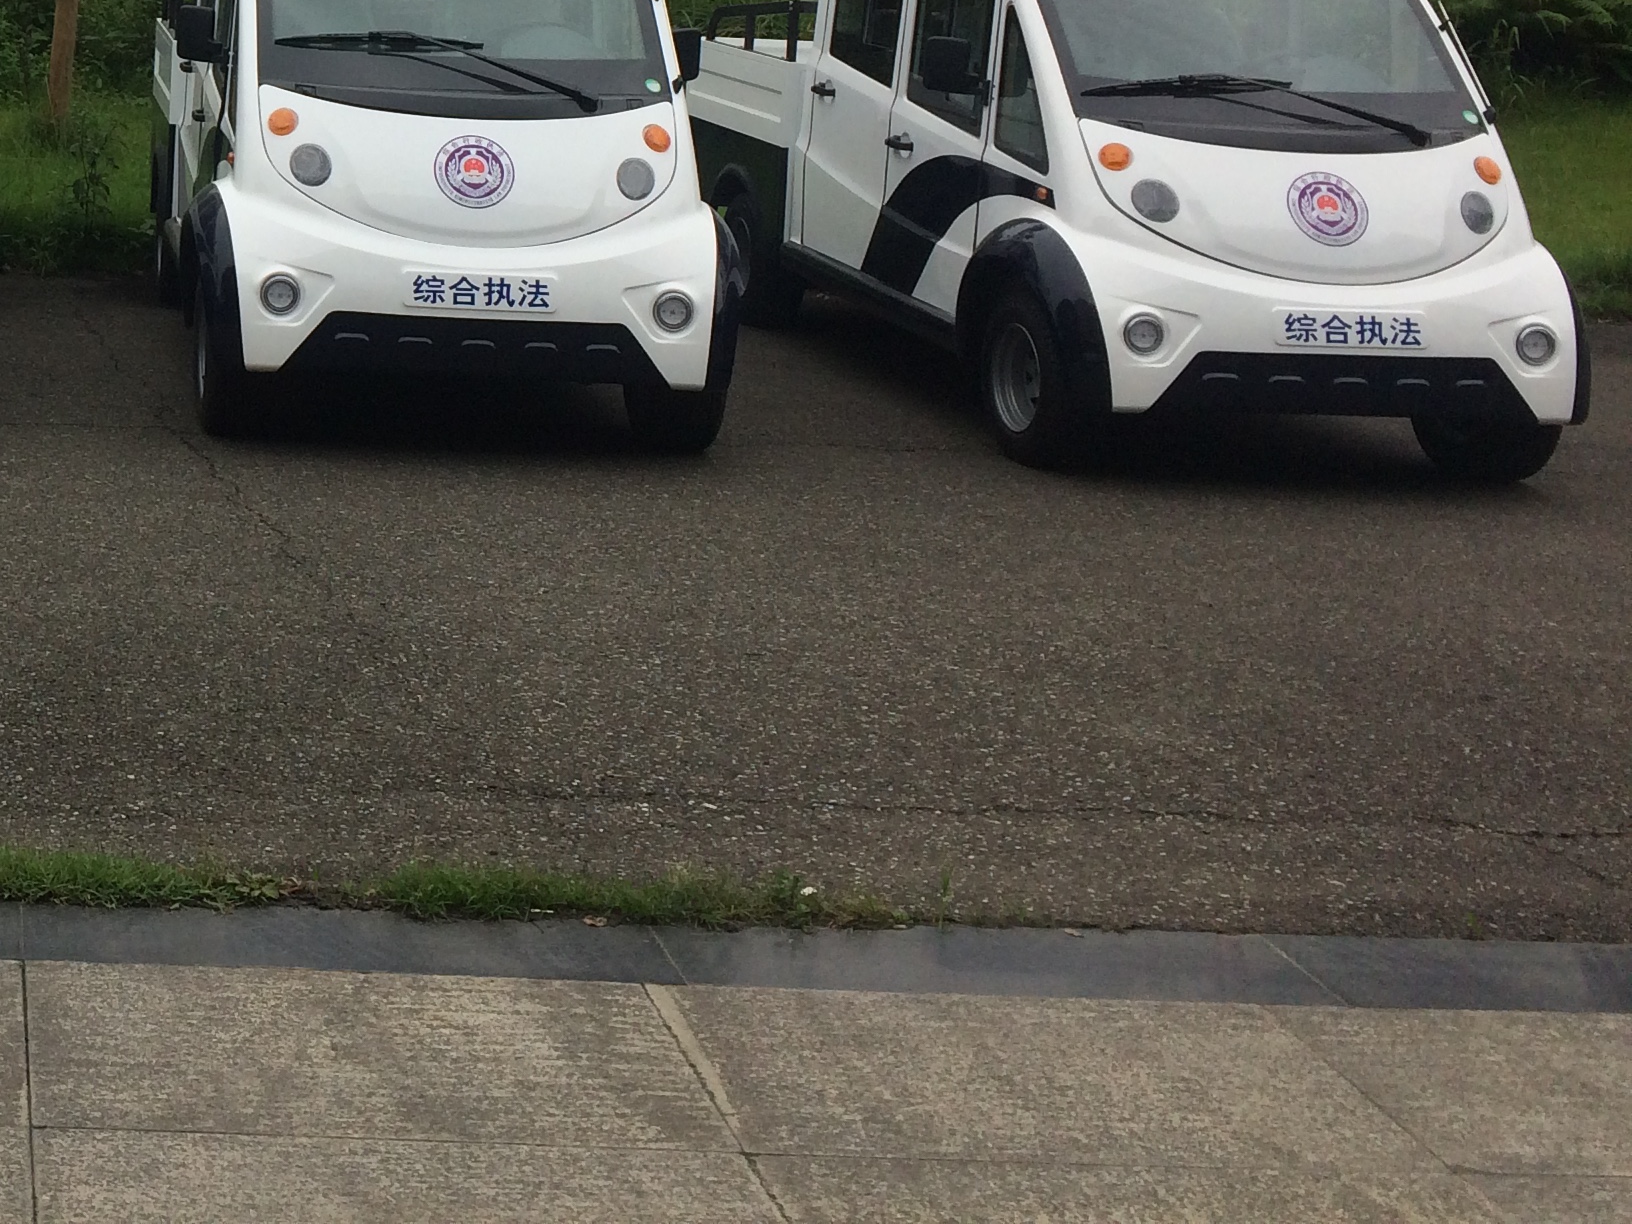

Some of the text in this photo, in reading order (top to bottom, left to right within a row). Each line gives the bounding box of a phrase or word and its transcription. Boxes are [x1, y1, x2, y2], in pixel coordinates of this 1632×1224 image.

[412, 274, 550, 309] 综合执法
[1284, 313, 1422, 347] 综合执法
